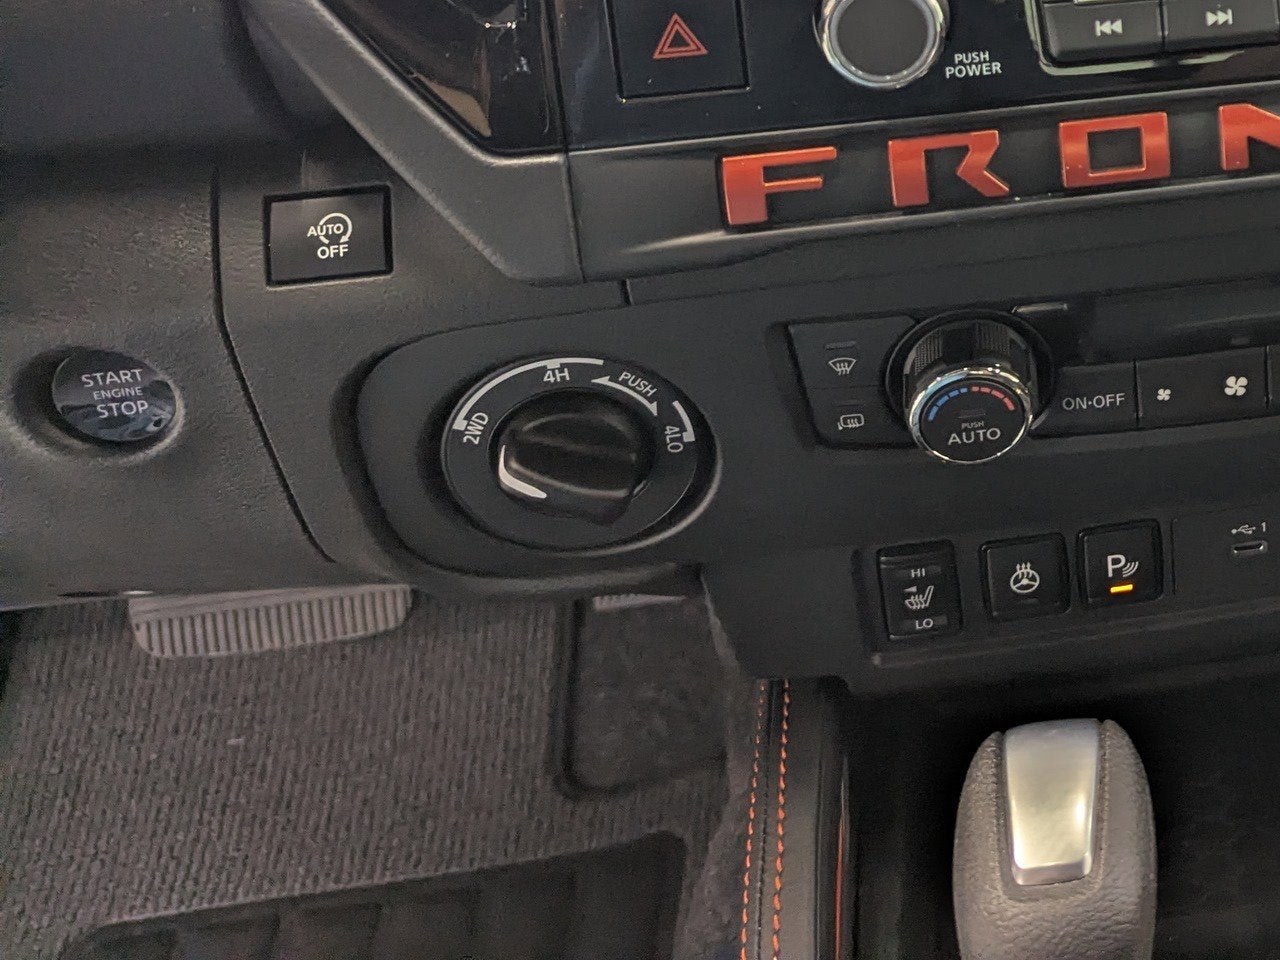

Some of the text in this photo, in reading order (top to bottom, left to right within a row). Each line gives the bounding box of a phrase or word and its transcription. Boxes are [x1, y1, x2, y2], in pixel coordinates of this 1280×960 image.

[954, 50, 990, 64] PUSH
[945, 62, 1002, 78] POWER
[307, 223, 344, 238] AUTO
[317, 244, 348, 259] OFF
[81, 368, 143, 388] START
[543, 368, 570, 384] 4H
[619, 372, 658, 397] PUSH
[93, 386, 143, 401] ENGINE
[96, 400, 148, 420] STOP
[463, 411, 489, 445] 2WD
[961, 420, 984, 430] PUSH
[664, 425, 684, 453] 4LO
[948, 427, 1000, 446] AUTO
[911, 568, 926, 578] HI
[916, 618, 934, 630] LO
